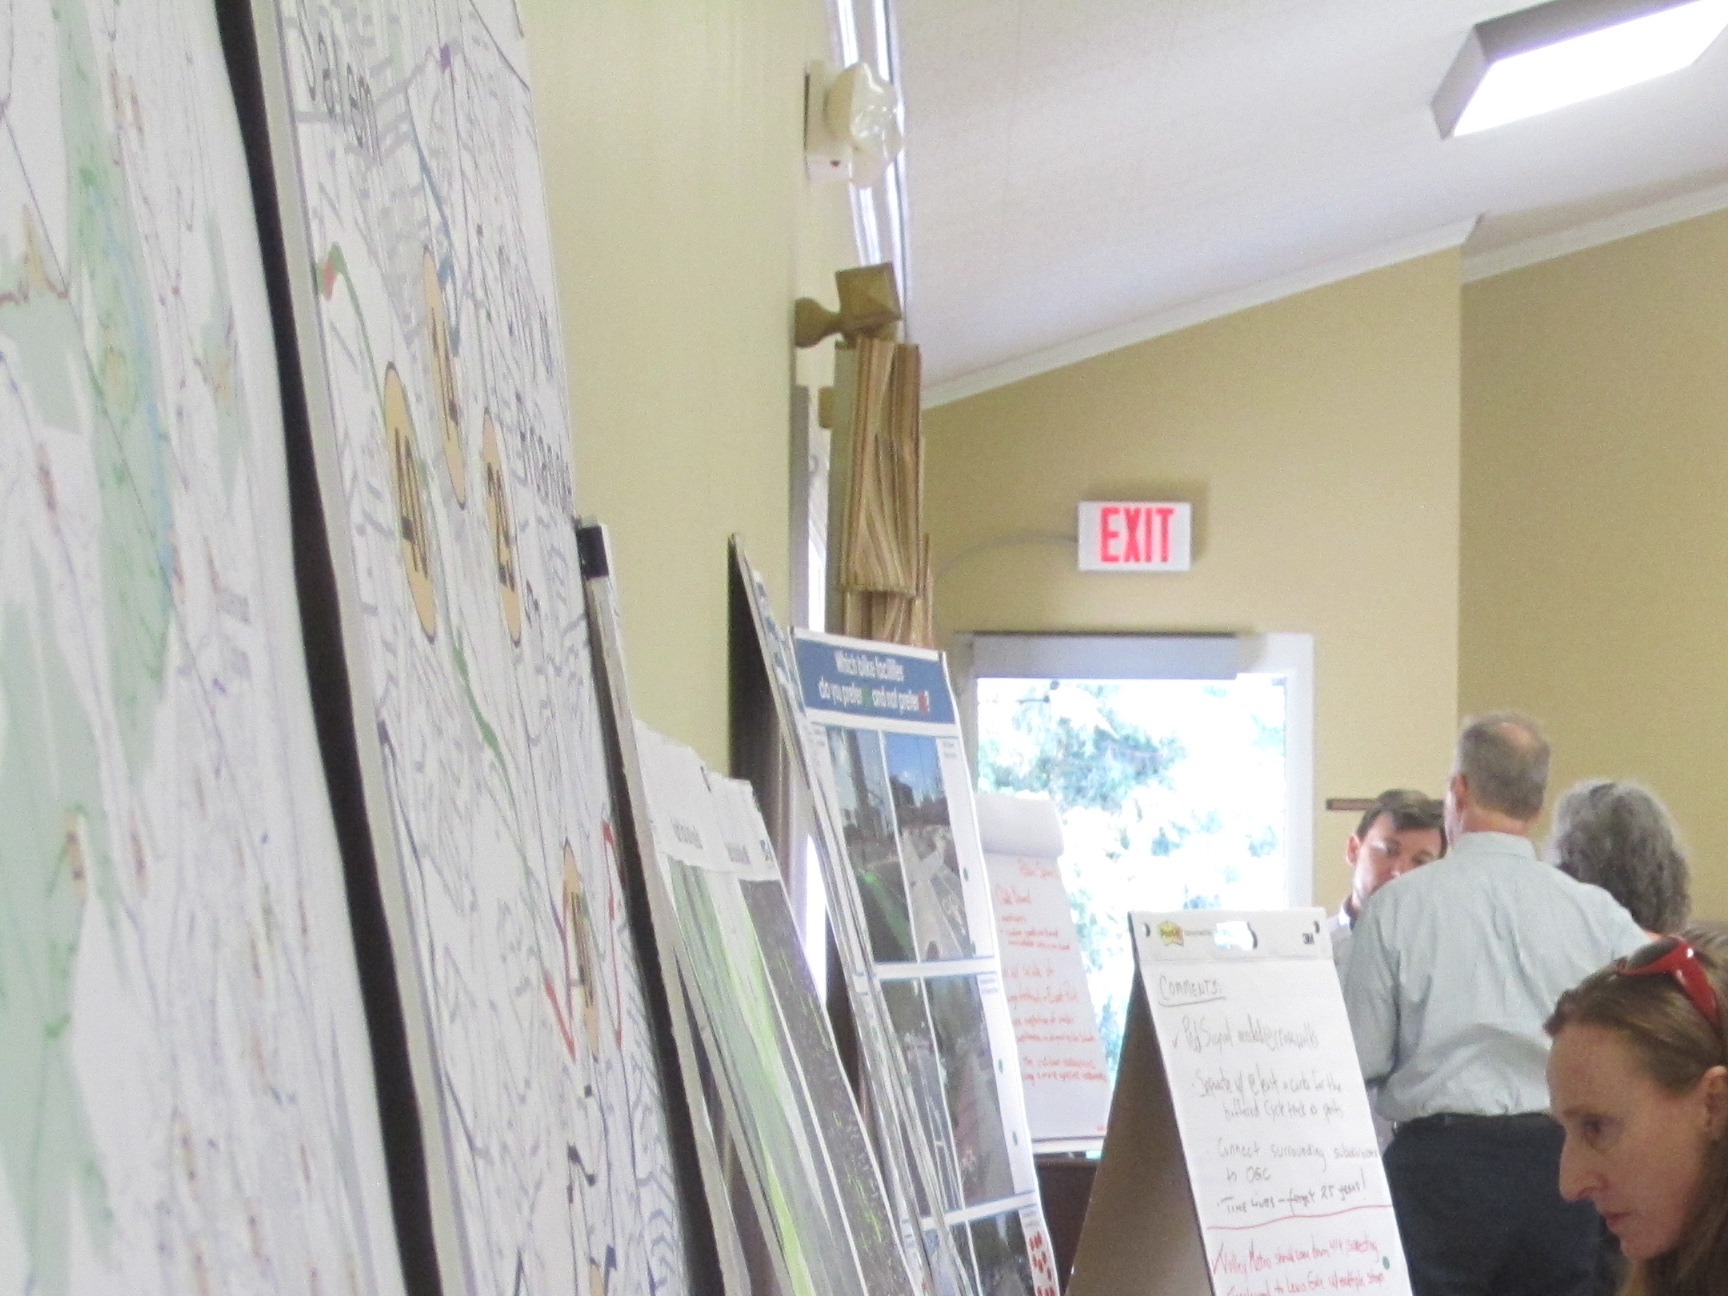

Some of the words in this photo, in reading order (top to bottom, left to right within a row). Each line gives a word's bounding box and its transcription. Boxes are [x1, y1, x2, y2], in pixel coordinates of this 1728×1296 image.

[1100, 506, 1175, 563] EXIT
[834, 650, 858, 675] Which
[858, 654, 876, 679] bike
[875, 656, 904, 682] facilities
[818, 676, 831, 699] do
[830, 682, 843, 706] you
[842, 682, 862, 707] prefer
[872, 685, 887, 708] and
[886, 686, 899, 709] not
[898, 689, 920, 715] prefer
[1302, 932, 1315, 945] 3M
[1320, 1185, 1336, 1200] 25
